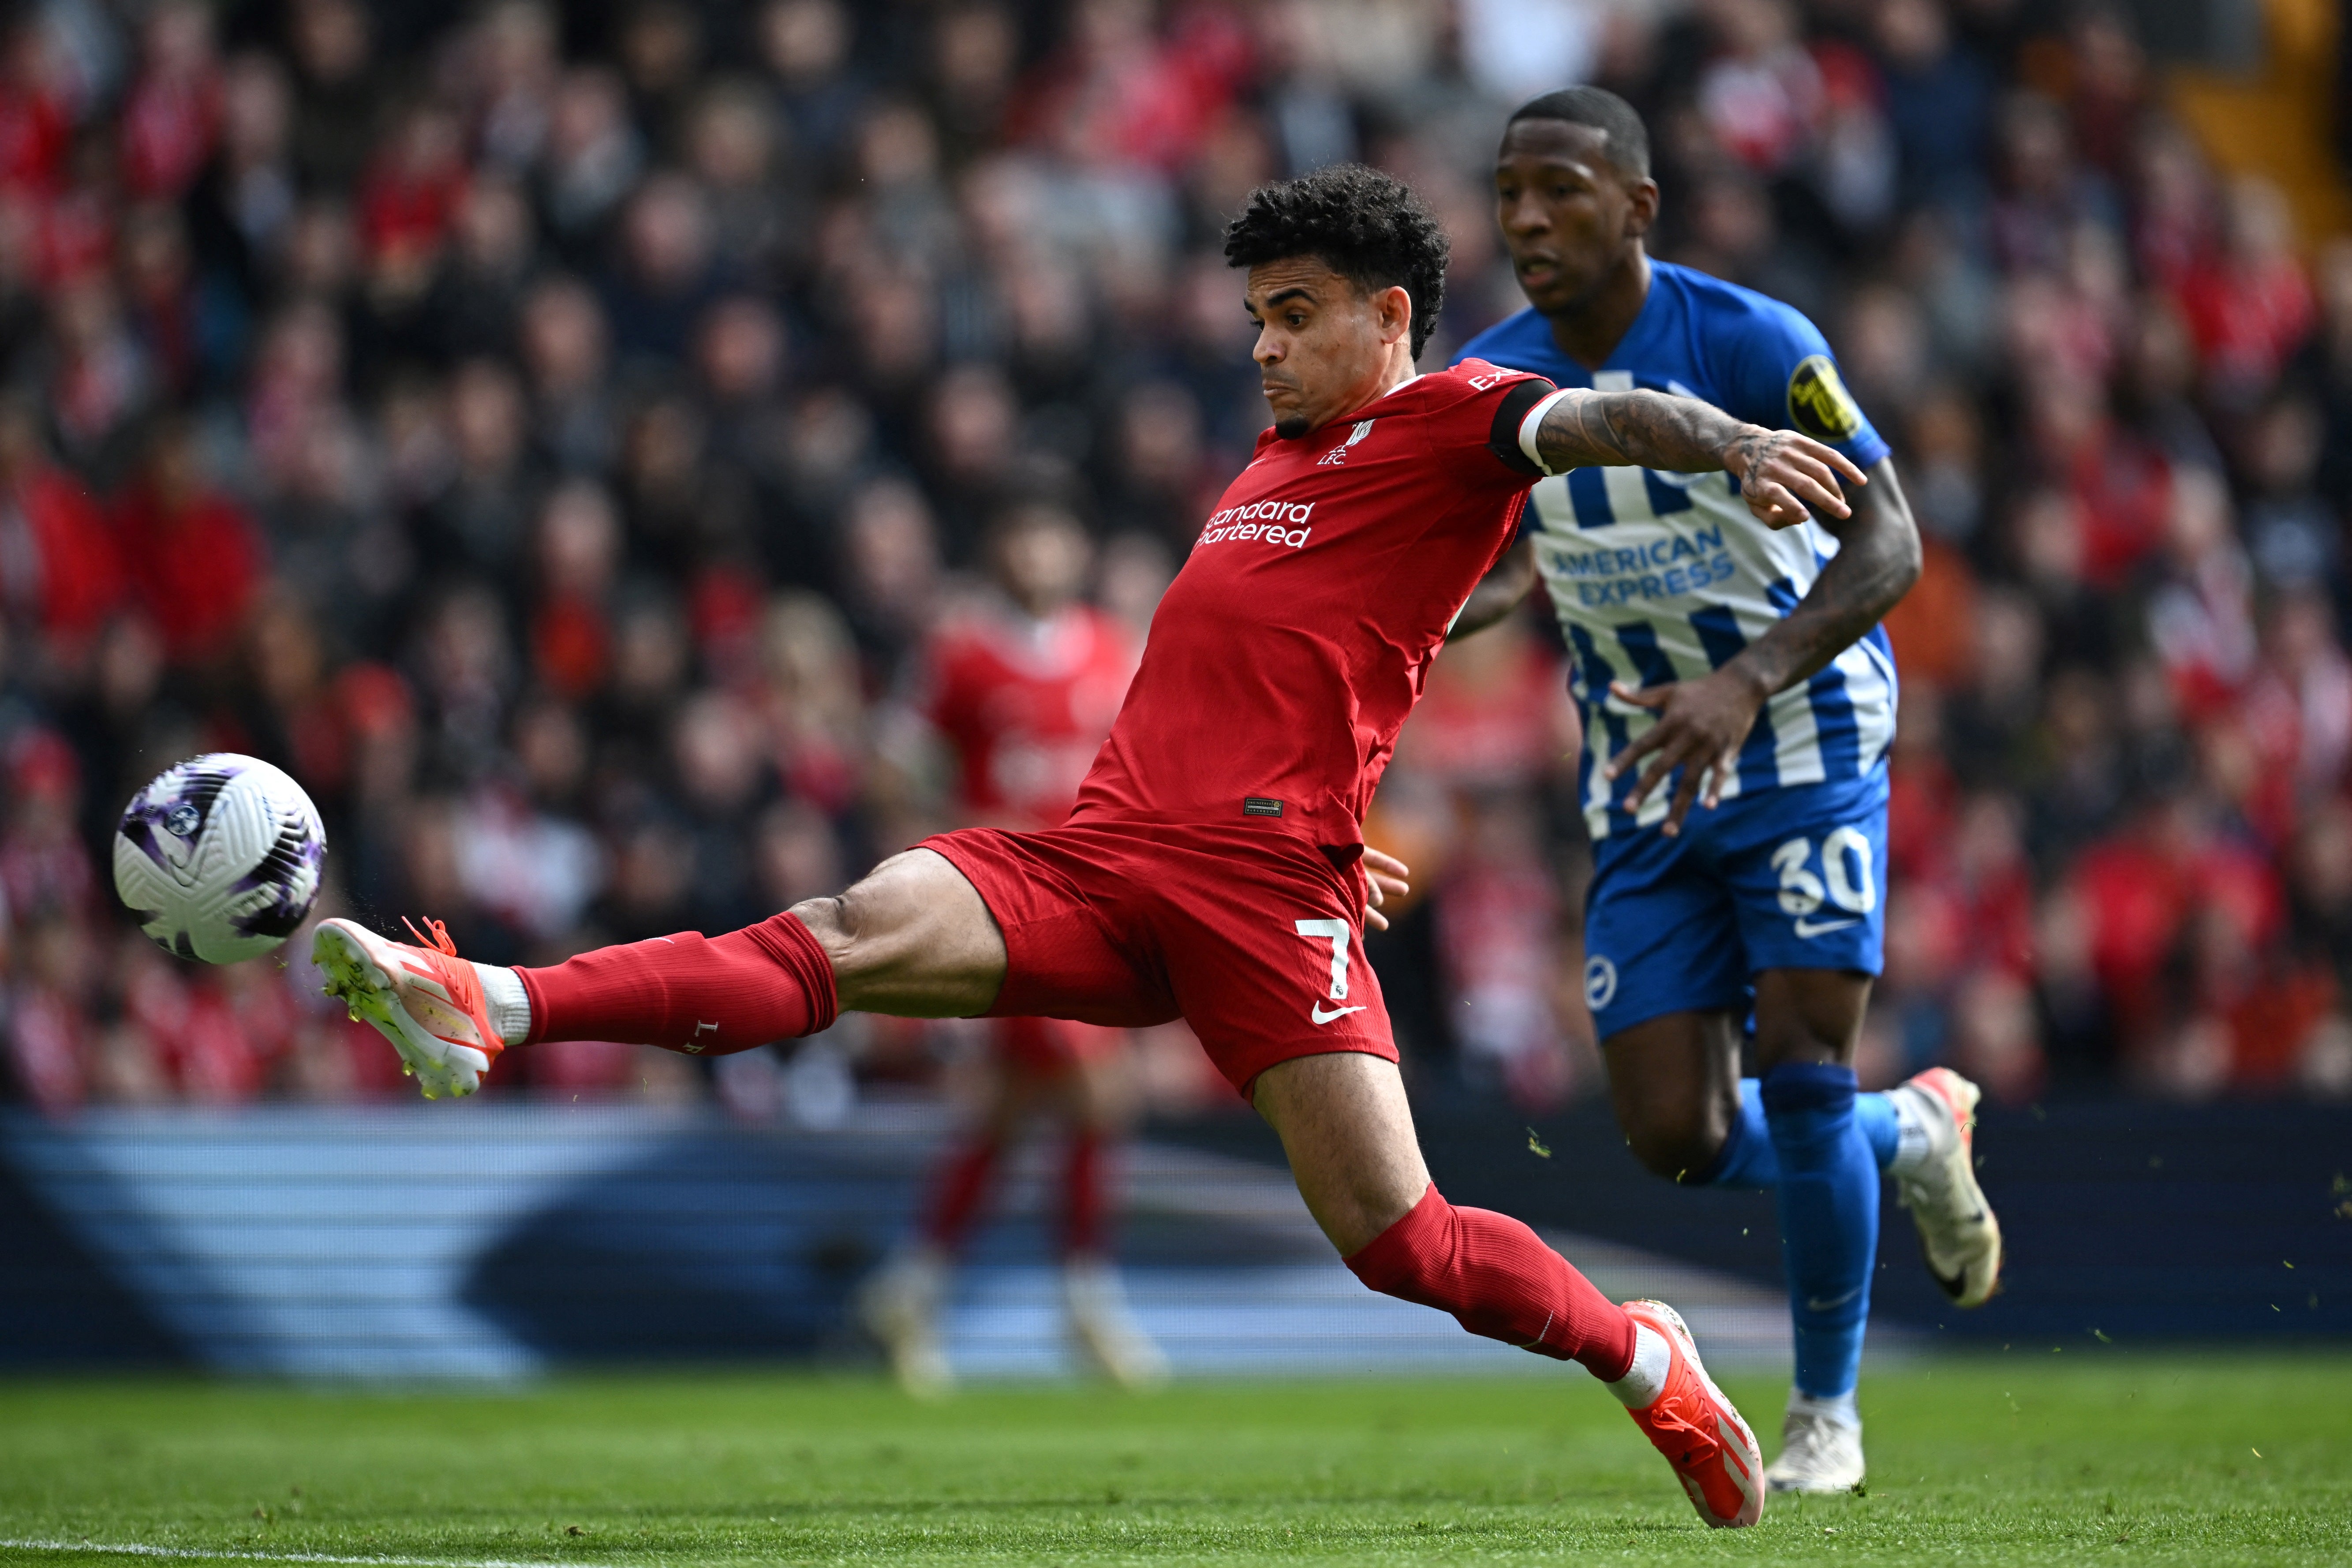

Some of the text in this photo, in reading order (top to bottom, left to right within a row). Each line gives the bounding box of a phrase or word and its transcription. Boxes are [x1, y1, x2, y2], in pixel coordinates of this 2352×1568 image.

[1554, 523, 1724, 576] AMERICAN
[1578, 551, 1735, 608] EXPRESS
[1770, 825, 1876, 916] 30
[1294, 918, 1350, 999] 7
